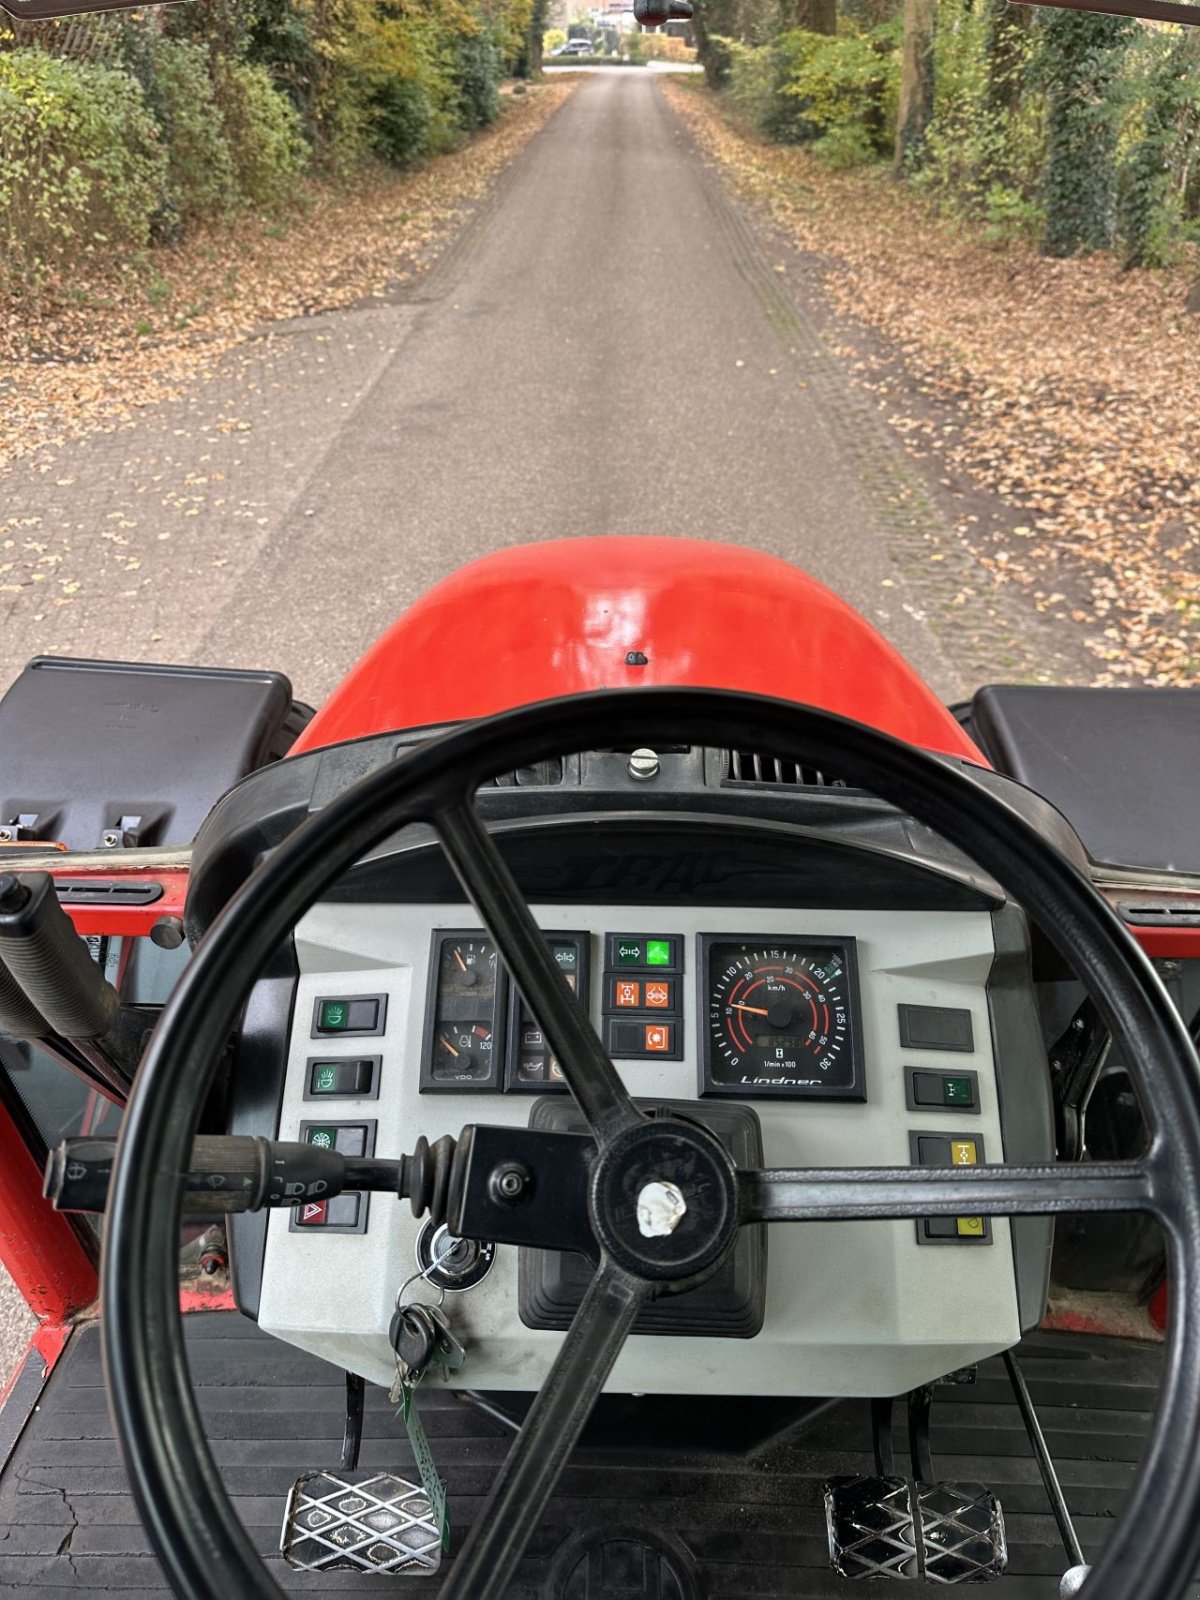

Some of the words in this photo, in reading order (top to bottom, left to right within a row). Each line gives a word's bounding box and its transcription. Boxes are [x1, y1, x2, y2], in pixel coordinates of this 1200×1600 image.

[770, 950, 780, 959] 15
[726, 966, 737, 977] 10
[744, 971, 754, 980] 20
[813, 967, 825, 980] 20
[803, 991, 812, 1000] 30
[818, 994, 826, 1003] 40
[725, 1007, 733, 1015] 10
[836, 1014, 846, 1024] 25
[808, 1030, 817, 1040] 40
[819, 1036, 828, 1045] 50
[480, 1041, 492, 1050] 120
[731, 1057, 739, 1066] 0
[763, 1060, 781, 1068] 1/min
[819, 1057, 832, 1070] 30
[741, 1076, 822, 1085] Lindner
[485, 1252, 491, 1261] S
